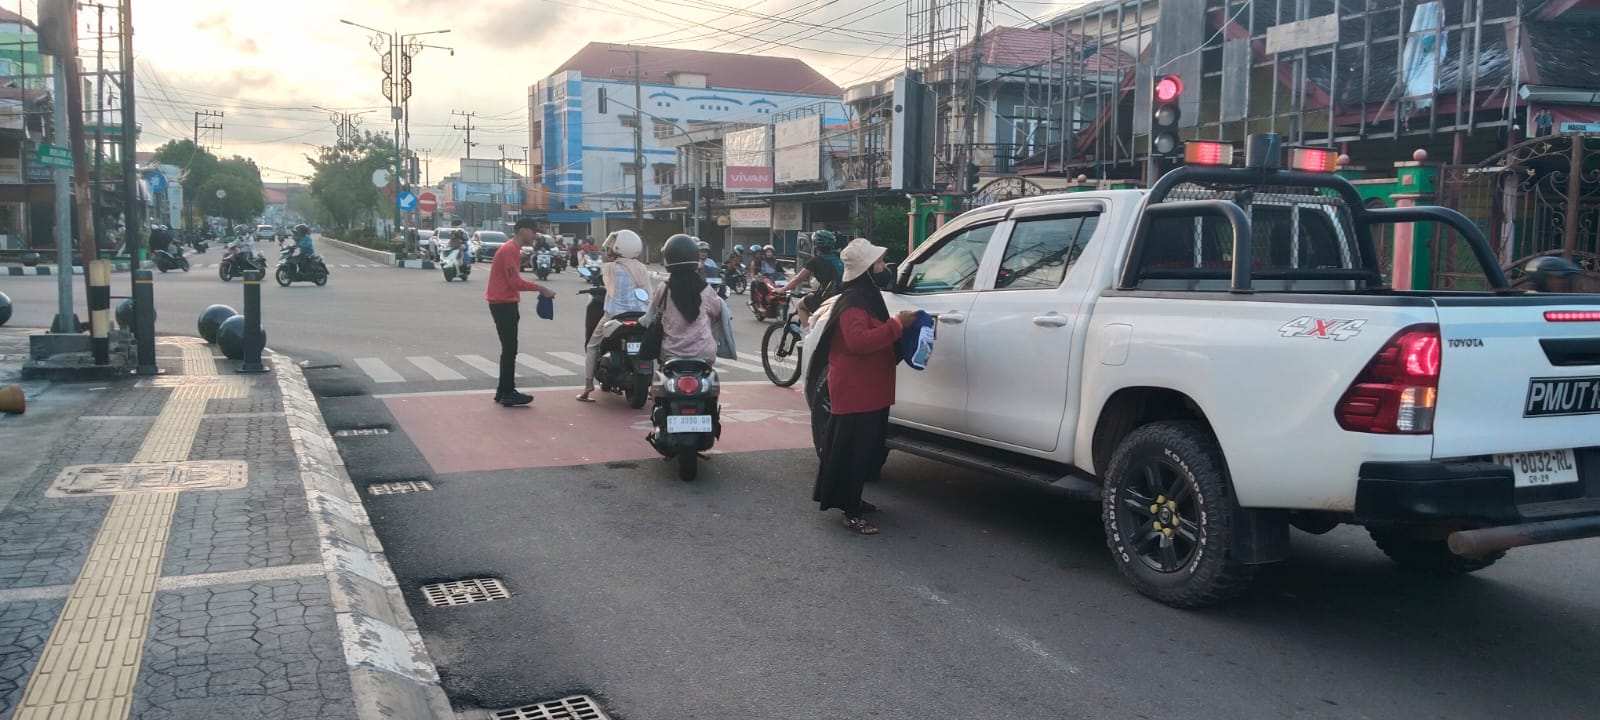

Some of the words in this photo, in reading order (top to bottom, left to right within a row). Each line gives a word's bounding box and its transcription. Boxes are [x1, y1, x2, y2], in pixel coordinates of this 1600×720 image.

[1448, 338, 1484, 348] TOYOTA
[1164, 448, 1204, 505] KOMODO
[1520, 451, 1553, 474] 8032
[1109, 487, 1120, 542] RADIAL
